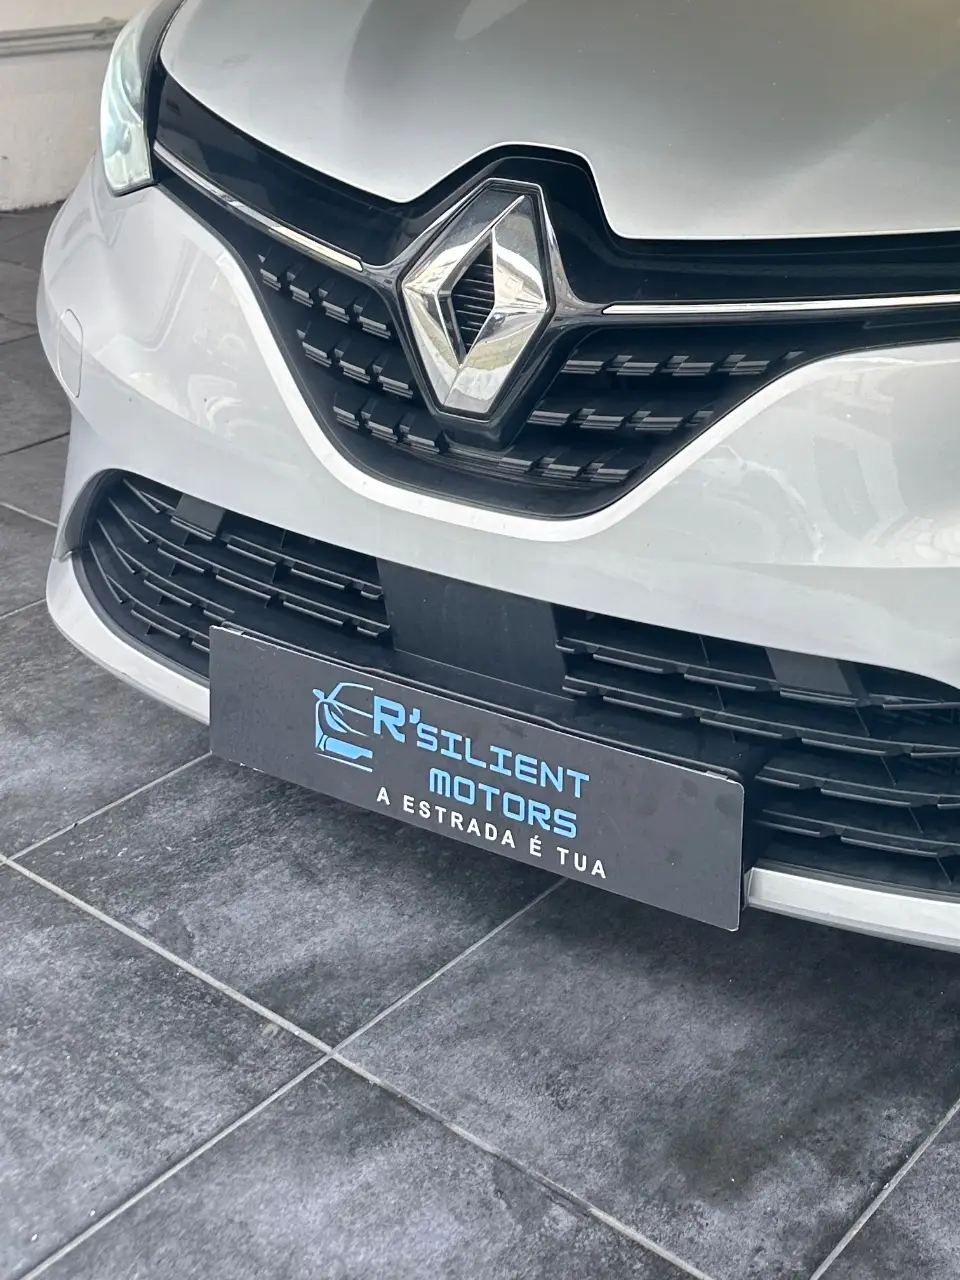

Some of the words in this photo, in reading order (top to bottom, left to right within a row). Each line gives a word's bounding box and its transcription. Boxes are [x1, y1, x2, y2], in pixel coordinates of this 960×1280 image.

[376, 786, 391, 806] A
[403, 794, 515, 849] ESTRADA
[529, 835, 542, 857] É
[556, 846, 606, 879] TUA
[429, 767, 577, 839] MOTORS
